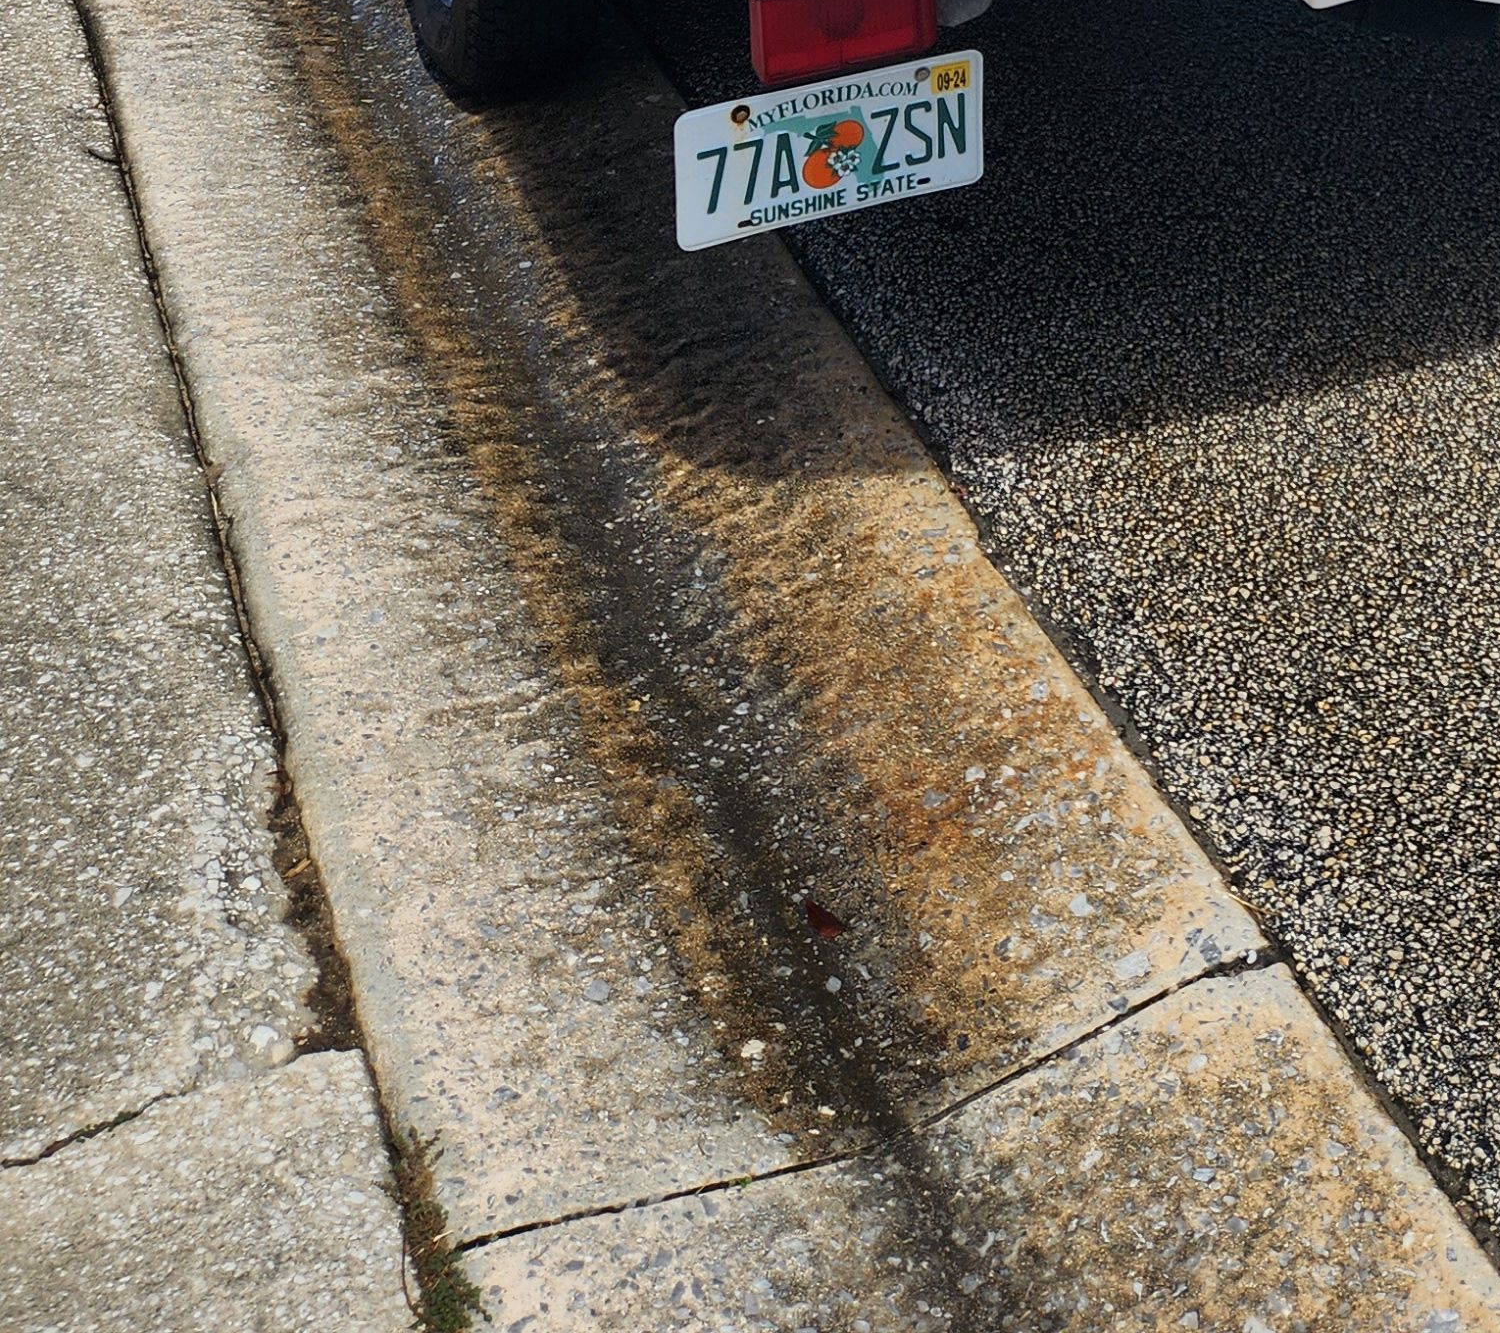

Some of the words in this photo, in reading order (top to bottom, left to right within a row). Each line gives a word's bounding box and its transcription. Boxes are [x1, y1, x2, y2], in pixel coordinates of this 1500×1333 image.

[936, 67, 968, 92] 09-24
[748, 82, 919, 132] MYFLORIDA.COM
[696, 133, 800, 214] 77A
[870, 93, 967, 175] ZSN
[750, 188, 847, 227] SUNSHINE
[856, 173, 917, 201] STATE
